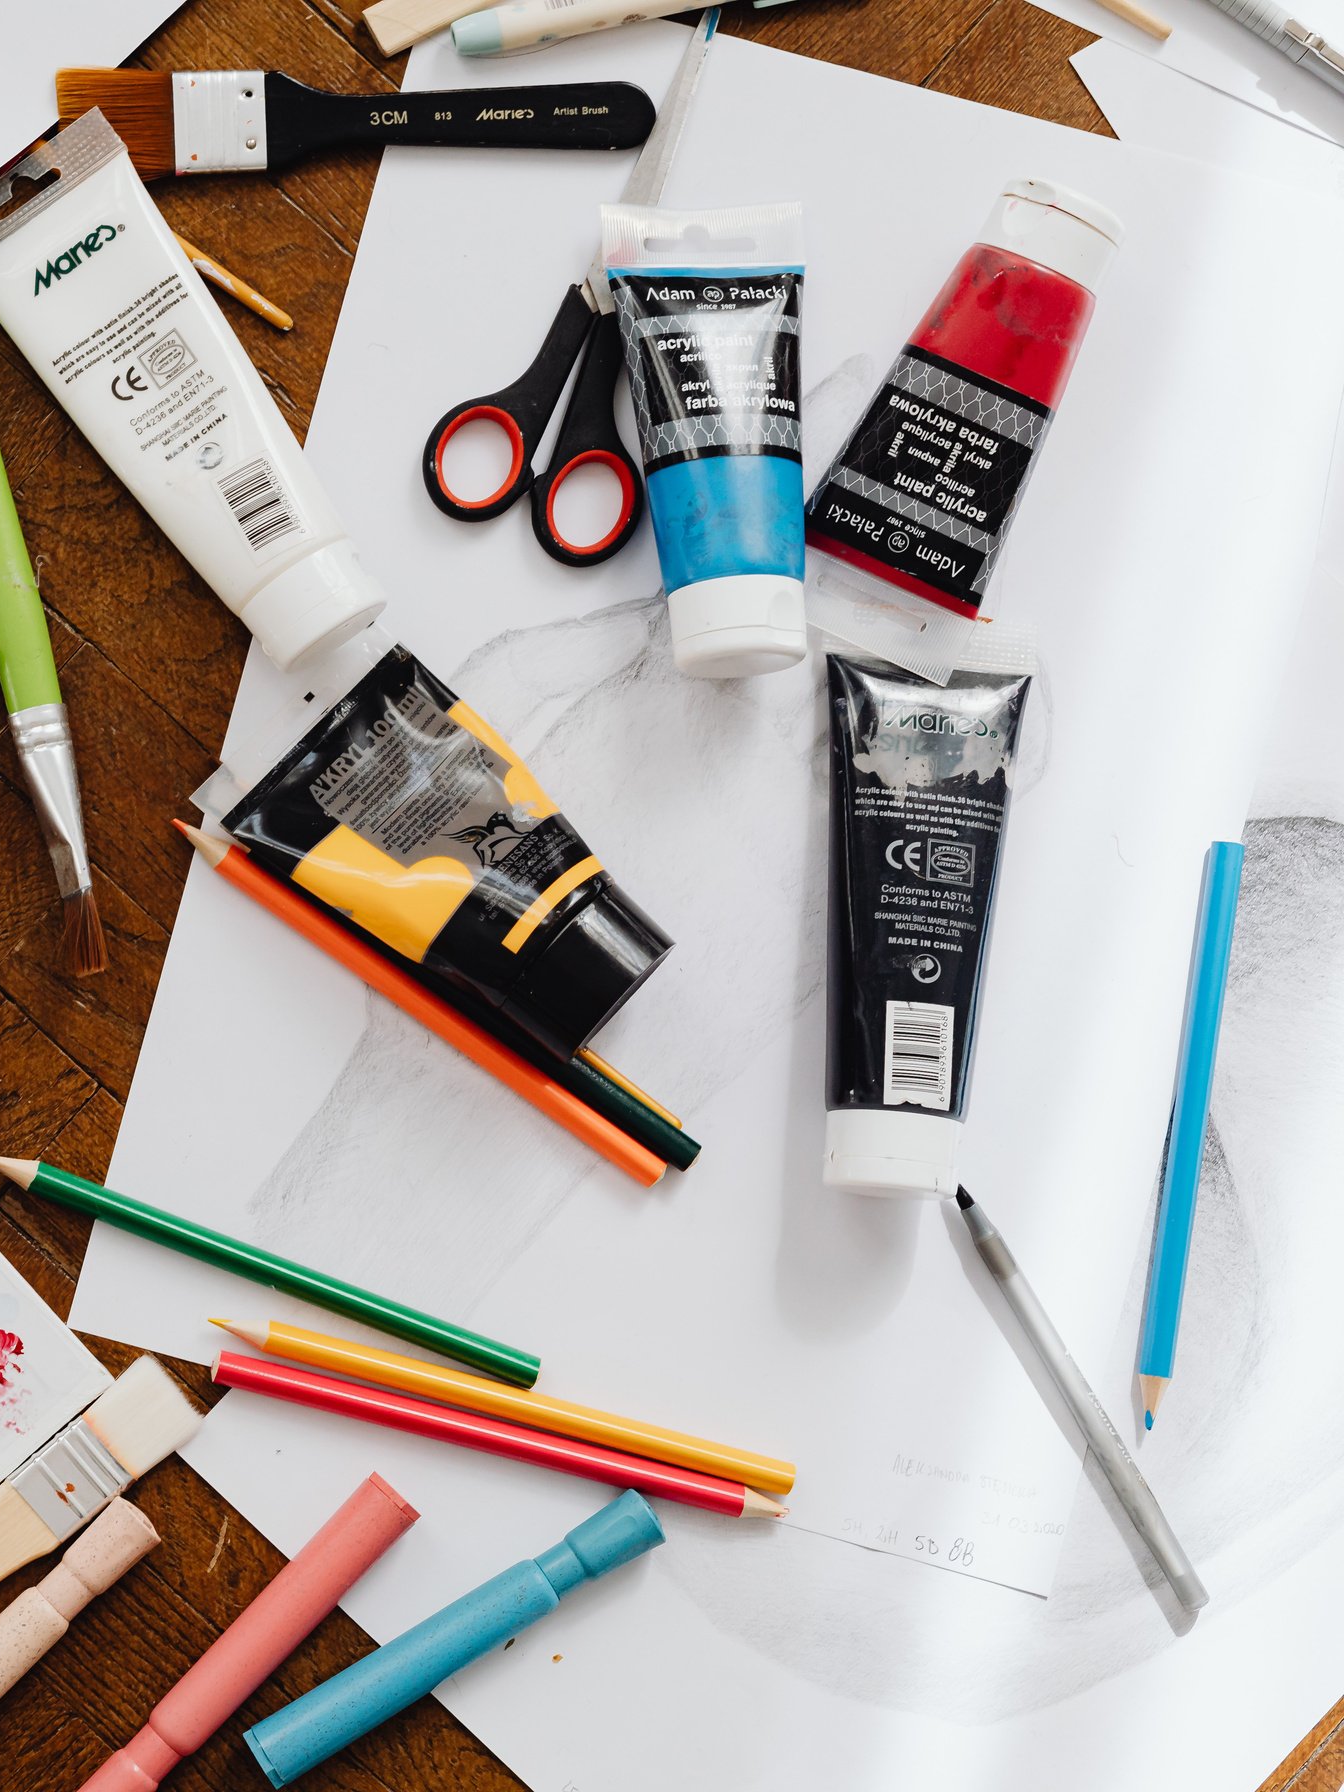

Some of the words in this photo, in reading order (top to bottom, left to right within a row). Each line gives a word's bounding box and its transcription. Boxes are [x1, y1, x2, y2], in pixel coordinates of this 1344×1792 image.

[370, 110, 409, 127] 3CM
[435, 111, 453, 122] 813
[554, 107, 578, 116] Artist
[582, 106, 610, 116] Brush
[646, 286, 696, 302] Adam
[91, 328, 104, 339] with
[681, 380, 710, 393] akryl
[129, 397, 171, 427] Conforms
[170, 390, 180, 399] to
[180, 369, 205, 392] ASTM
[135, 411, 167, 436] D-4236
[167, 399, 184, 414] and
[183, 375, 214, 402] EN71-3
[685, 395, 728, 410] farba
[733, 395, 796, 411] akrylowa
[889, 395, 956, 432] akrylowa
[165, 441, 189, 461] MADE
[190, 434, 200, 443] IN
[201, 413, 226, 435] CHINA
[887, 431, 905, 457] akril
[902, 421, 952, 449] acrylique
[959, 427, 999, 455] farba
[942, 442, 963, 473] akrila
[963, 451, 992, 469] akryl
[894, 472, 935, 497] paint
[935, 473, 975, 497] acrilico
[936, 492, 987, 522] acrylic
[886, 516, 903, 528] 1987
[904, 524, 926, 538] since
[916, 545, 965, 577] Adam
[855, 785, 880, 796] Acrylic
[881, 788, 902, 797] colour
[904, 790, 919, 798] with
[966, 797, 986, 808] bright
[854, 797, 876, 806] which
[953, 807, 962, 815] be
[962, 808, 982, 818] mixed
[854, 808, 879, 818] acrylic
[879, 810, 905, 819] colours
[915, 814, 929, 822] well
[939, 815, 954, 825] with
[954, 818, 966, 826] the
[905, 823, 929, 834] acrylic
[929, 826, 960, 838] painting.
[493, 832, 540, 878] RENESANS
[934, 845, 969, 858] APPROVED
[881, 884, 930, 896] Conforms
[932, 889, 941, 898] to
[942, 891, 971, 903] ASTM
[880, 895, 918, 906] D-4236
[920, 900, 938, 908] and
[940, 901, 974, 914] EN71-3
[874, 912, 911, 921] SHANGHAI
[927, 917, 948, 926] MARIE
[949, 920, 976, 931] PAINTING
[895, 922, 934, 933] MATERIALS
[888, 936, 918, 946] MADE
[920, 939, 931, 947] IN
[933, 941, 963, 952] CHINA
